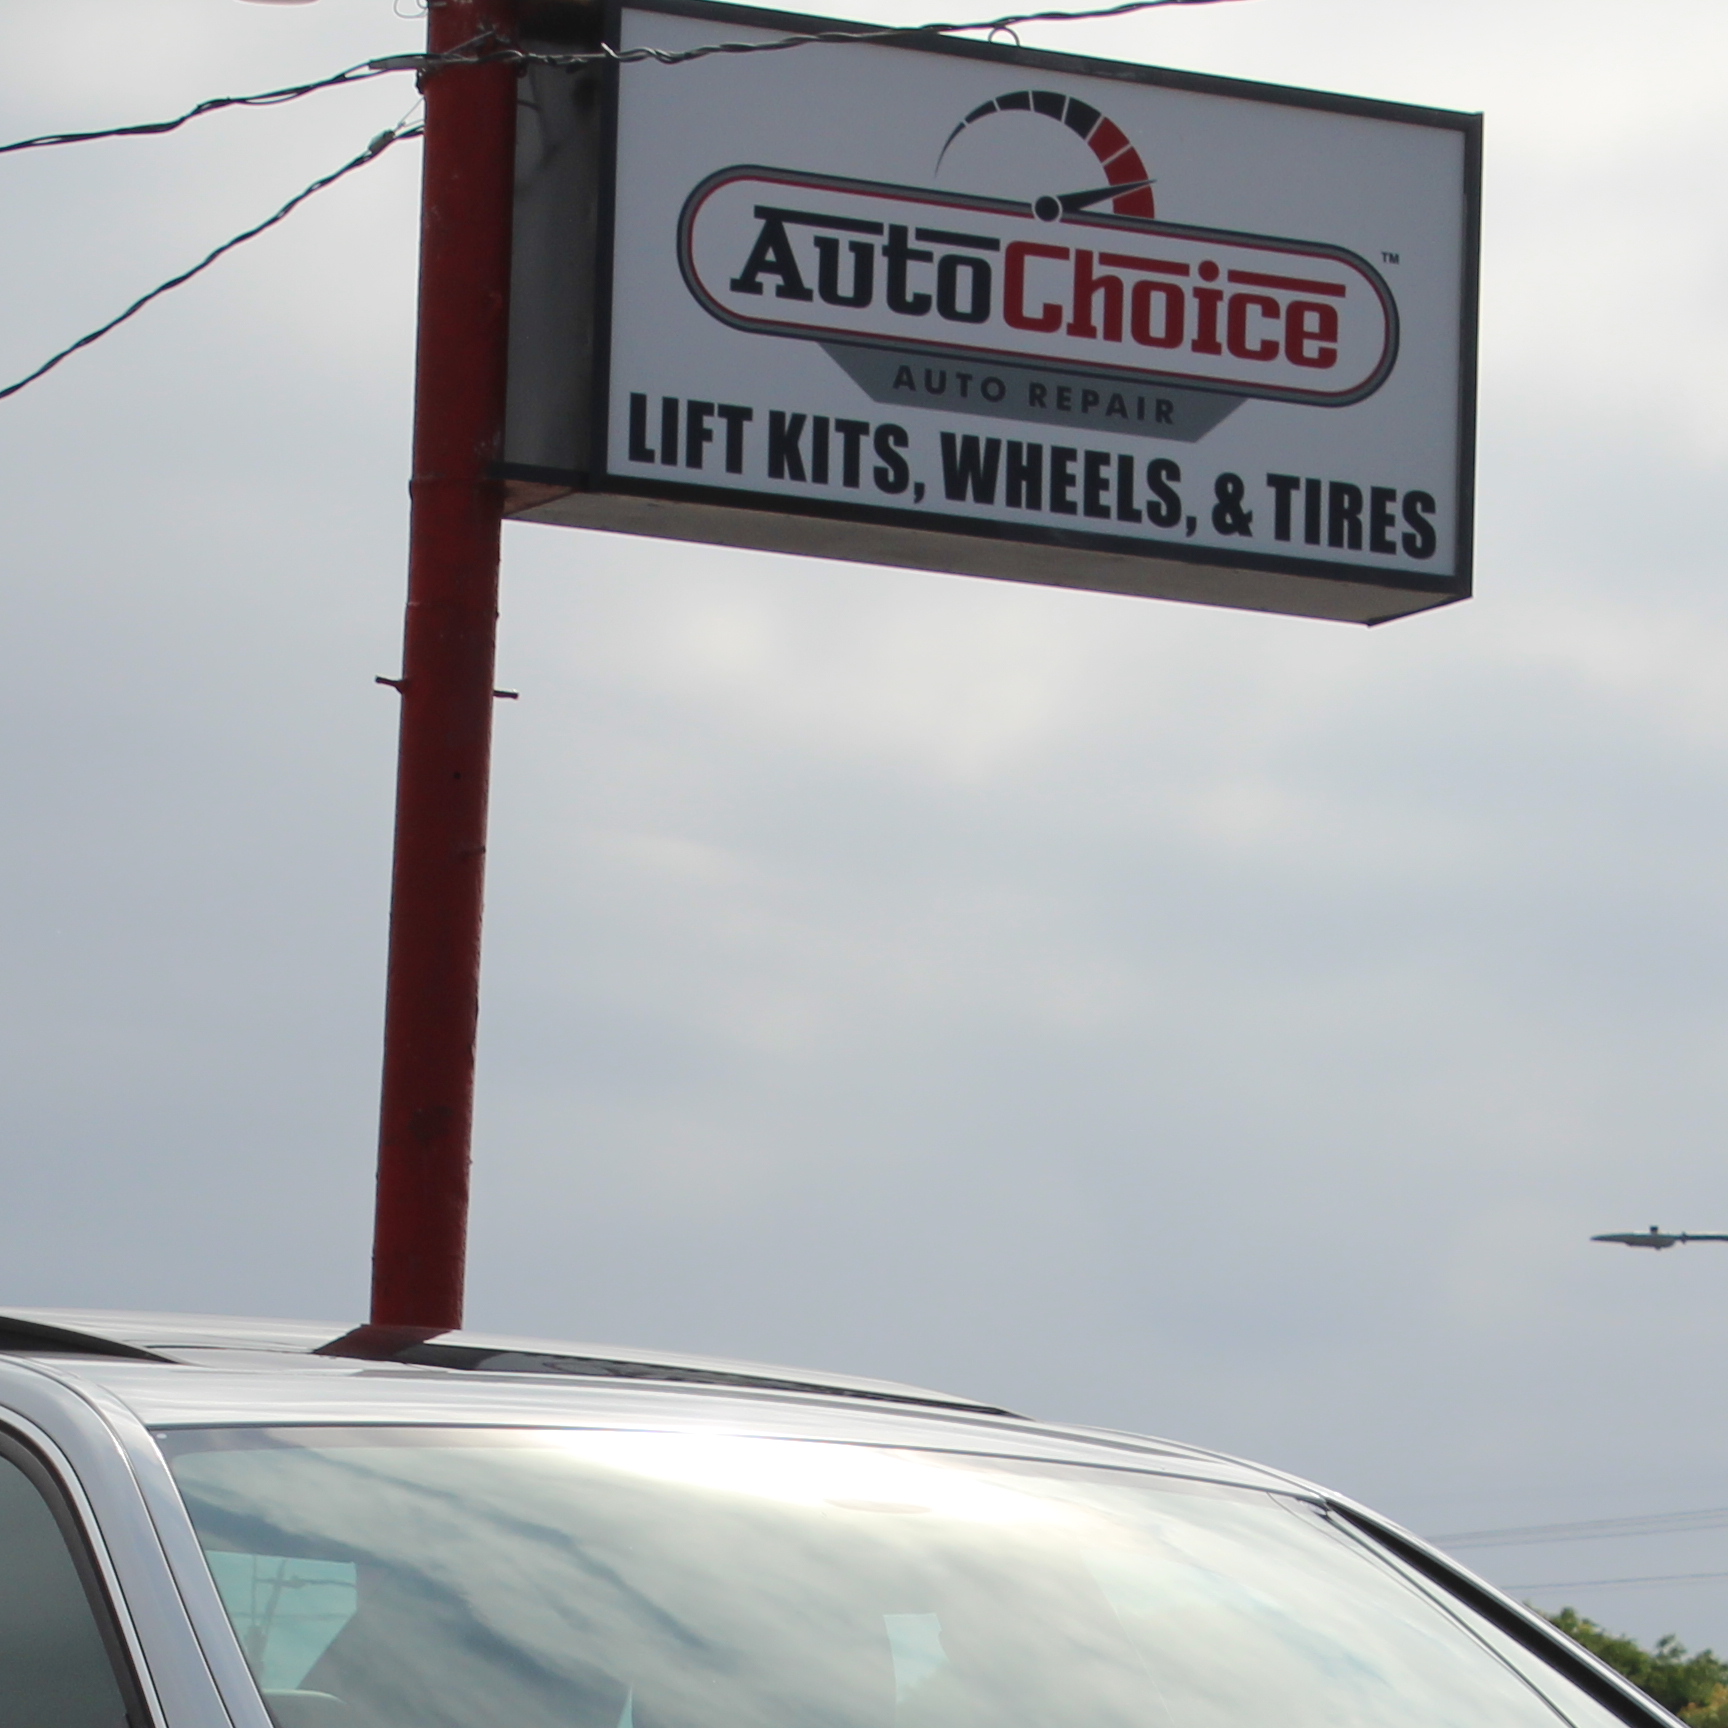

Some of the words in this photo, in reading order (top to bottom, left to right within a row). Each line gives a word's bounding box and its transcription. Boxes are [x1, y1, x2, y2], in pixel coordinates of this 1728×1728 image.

[729, 204, 1347, 370] AutoChoice
[628, 392, 753, 475] LIFT
[768, 409, 925, 504] KITS,
[940, 431, 1197, 538] WHEELS,
[1211, 472, 1253, 538] &
[1266, 472, 1437, 560] TIRES
[892, 365, 1006, 403] AUTO
[1028, 381, 1175, 425] REPAIR
